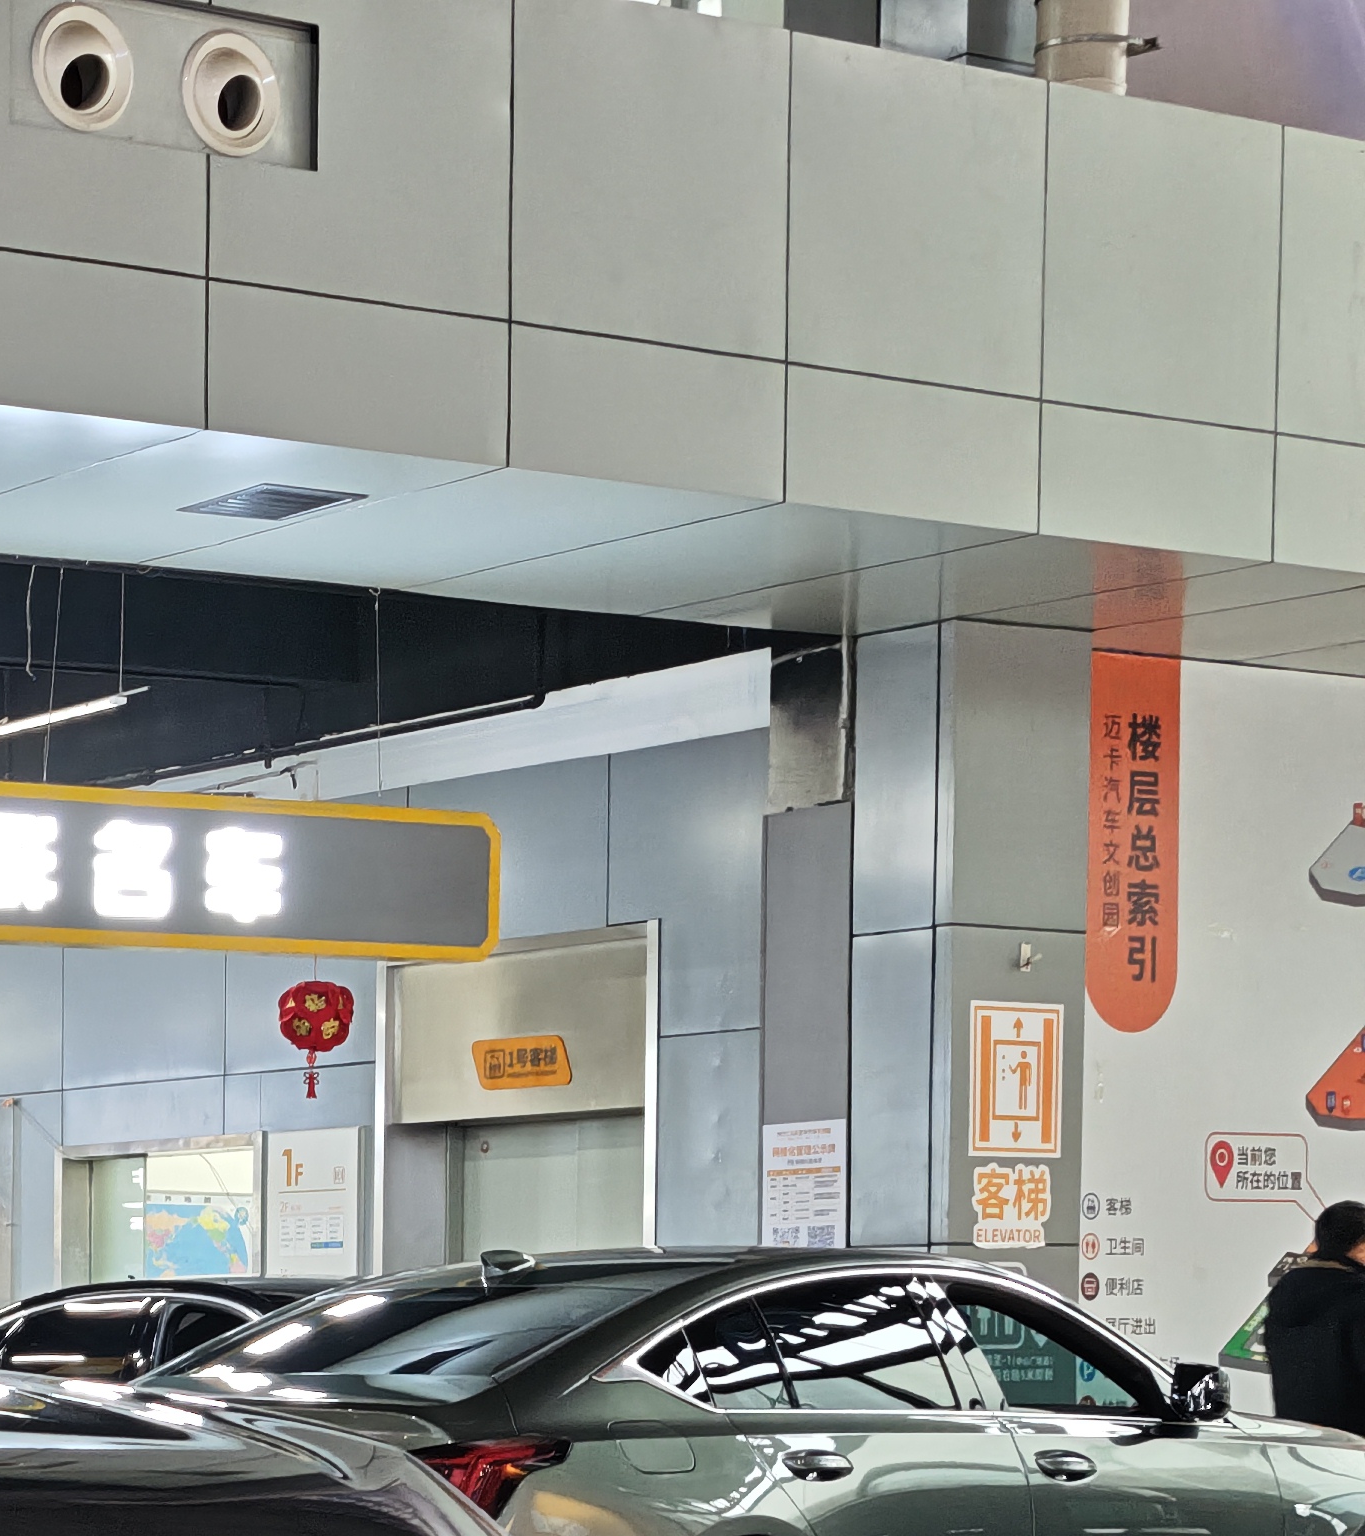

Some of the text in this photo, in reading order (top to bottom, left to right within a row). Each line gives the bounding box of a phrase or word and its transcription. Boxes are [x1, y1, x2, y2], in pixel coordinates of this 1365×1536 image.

[1102, 713, 1122, 928] 迈卡汽车文创园
[1126, 712, 1162, 983] 楼层总索引
[507, 1045, 557, 1068] 1号客梯
[282, 1149, 304, 1187] 1F
[1236, 1146, 1276, 1168] 当前您
[1235, 1170, 1303, 1192] 所在的位置
[975, 1168, 1048, 1222] 客梯
[1105, 1196, 1133, 1216] 客梯
[975, 1228, 1042, 1243] ELEVATOR
[1105, 1237, 1145, 1256] 卫生间
[1105, 1277, 1144, 1296] 便利店
